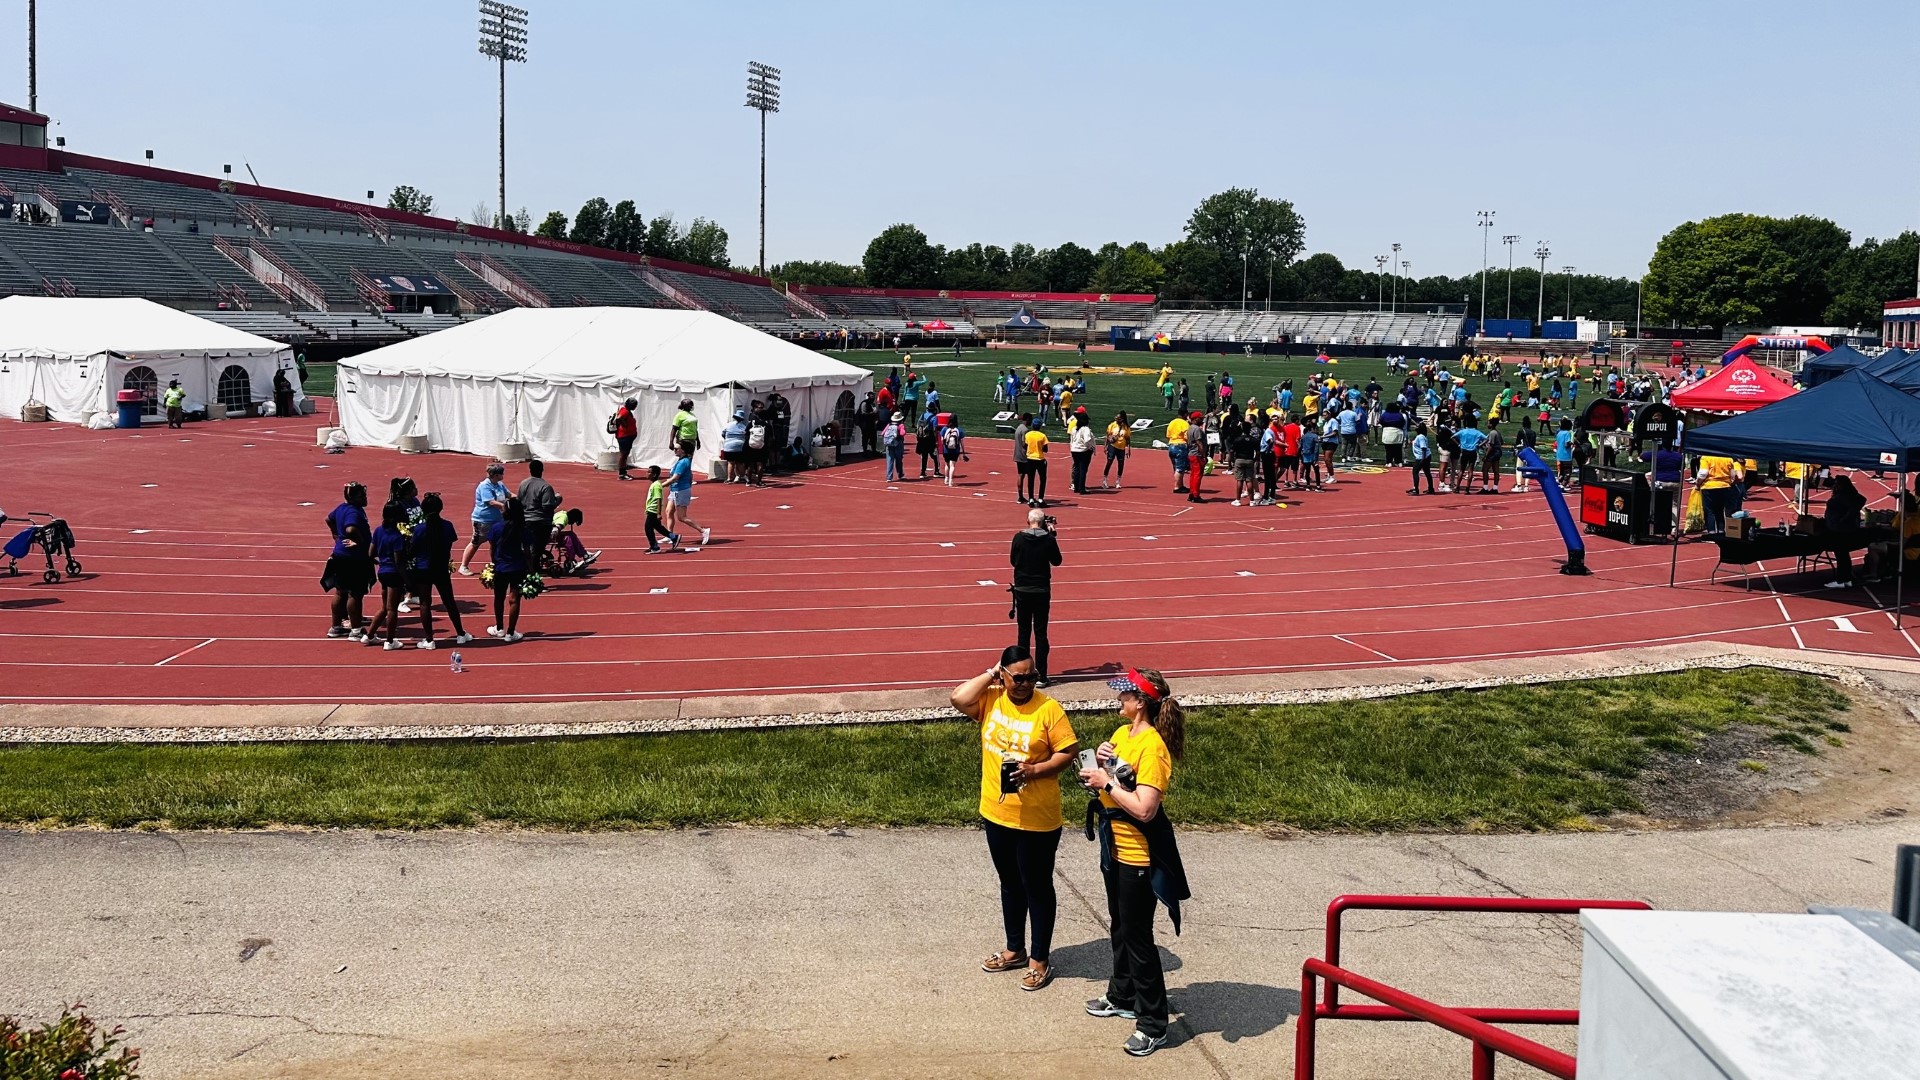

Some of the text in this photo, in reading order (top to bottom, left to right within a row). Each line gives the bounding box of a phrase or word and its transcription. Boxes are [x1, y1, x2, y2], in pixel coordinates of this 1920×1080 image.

[1757, 337, 1806, 348] START
[1646, 422, 1667, 432] IUPUI
[1608, 510, 1629, 526] IUPUI
